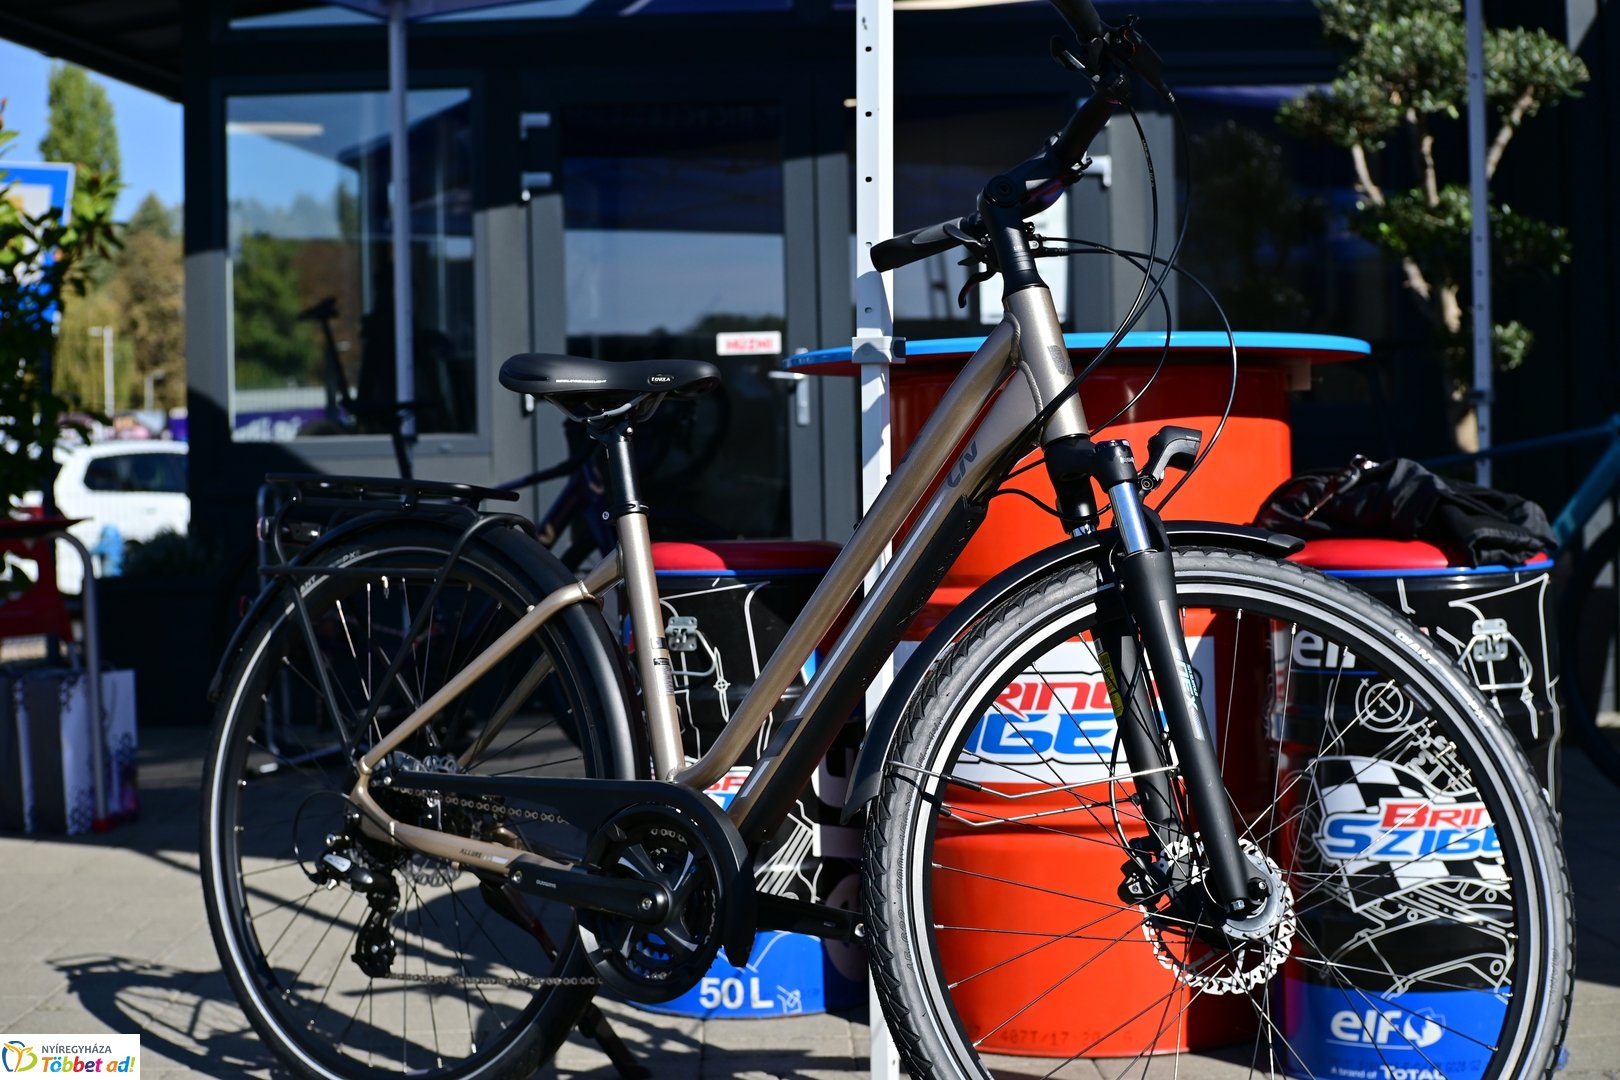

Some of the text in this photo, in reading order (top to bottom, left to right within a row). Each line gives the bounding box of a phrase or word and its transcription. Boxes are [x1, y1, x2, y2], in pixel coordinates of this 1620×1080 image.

[699, 977, 774, 1009] 50 L
[1331, 1010, 1402, 1044] elf
